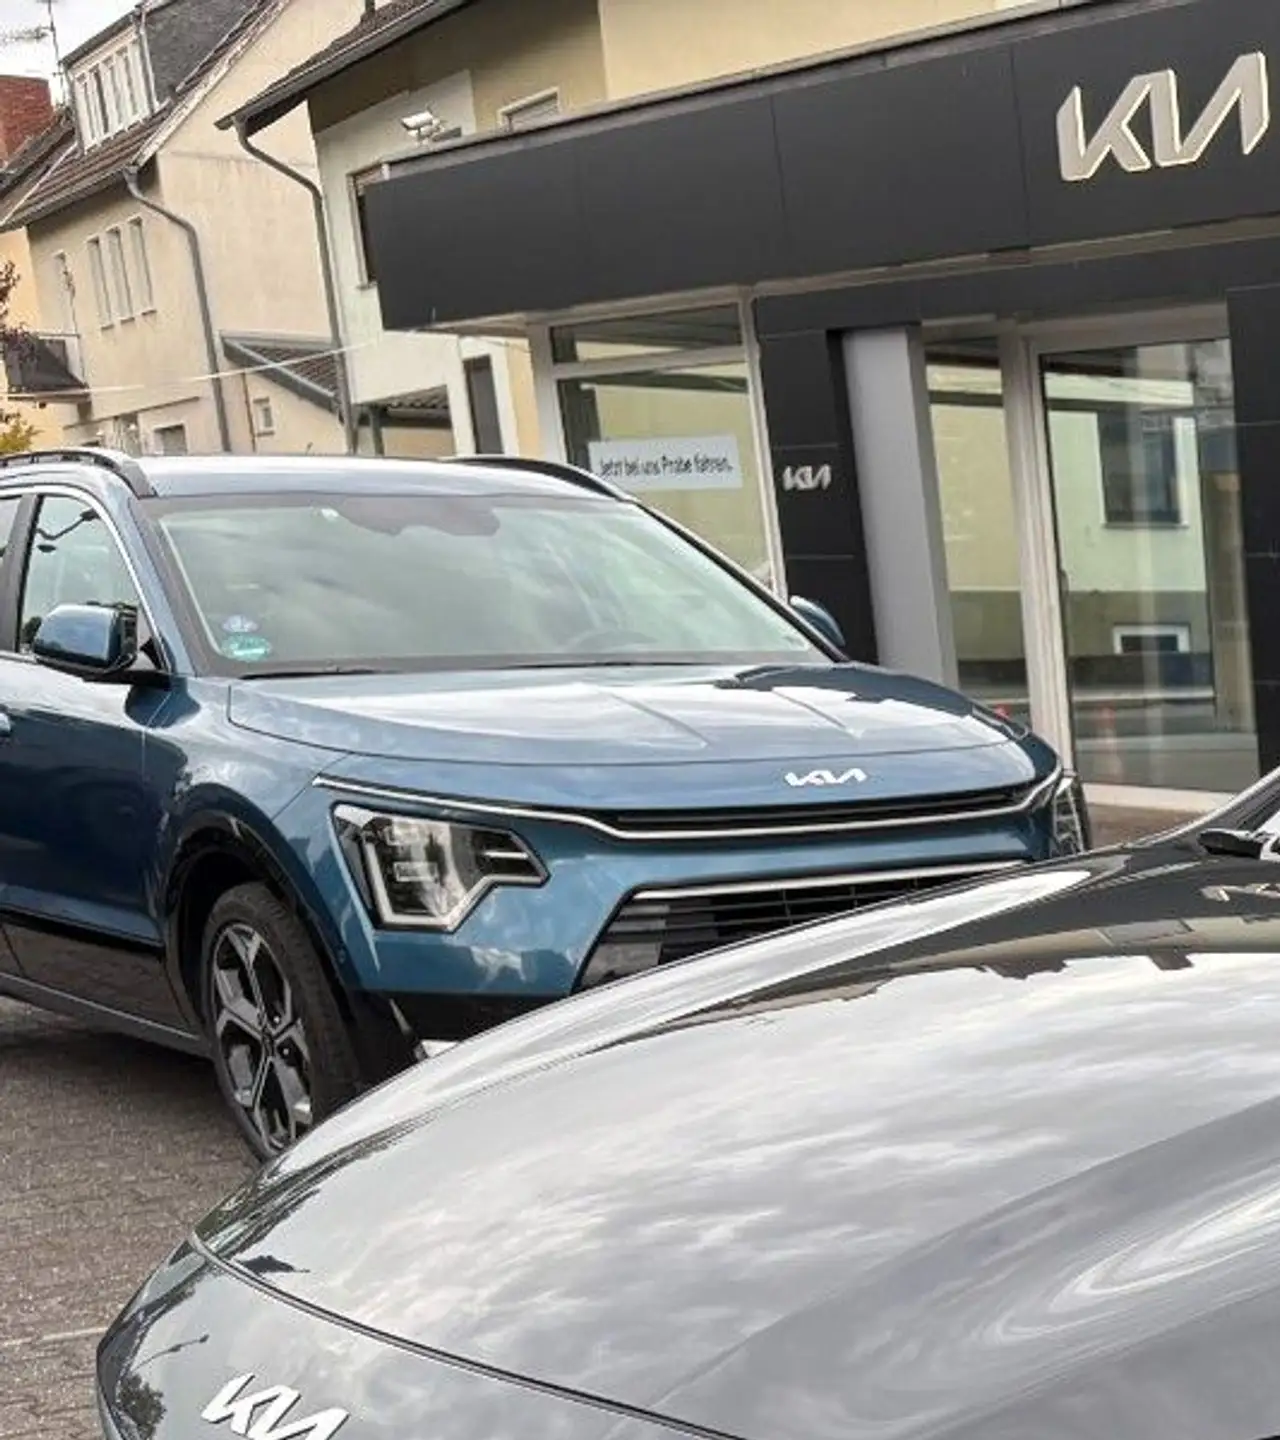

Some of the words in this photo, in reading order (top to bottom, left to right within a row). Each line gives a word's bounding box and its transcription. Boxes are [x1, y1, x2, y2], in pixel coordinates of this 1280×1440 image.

[1057, 51, 1268, 181] KIA
[782, 464, 832, 490] KIA
[785, 768, 867, 785] KIA
